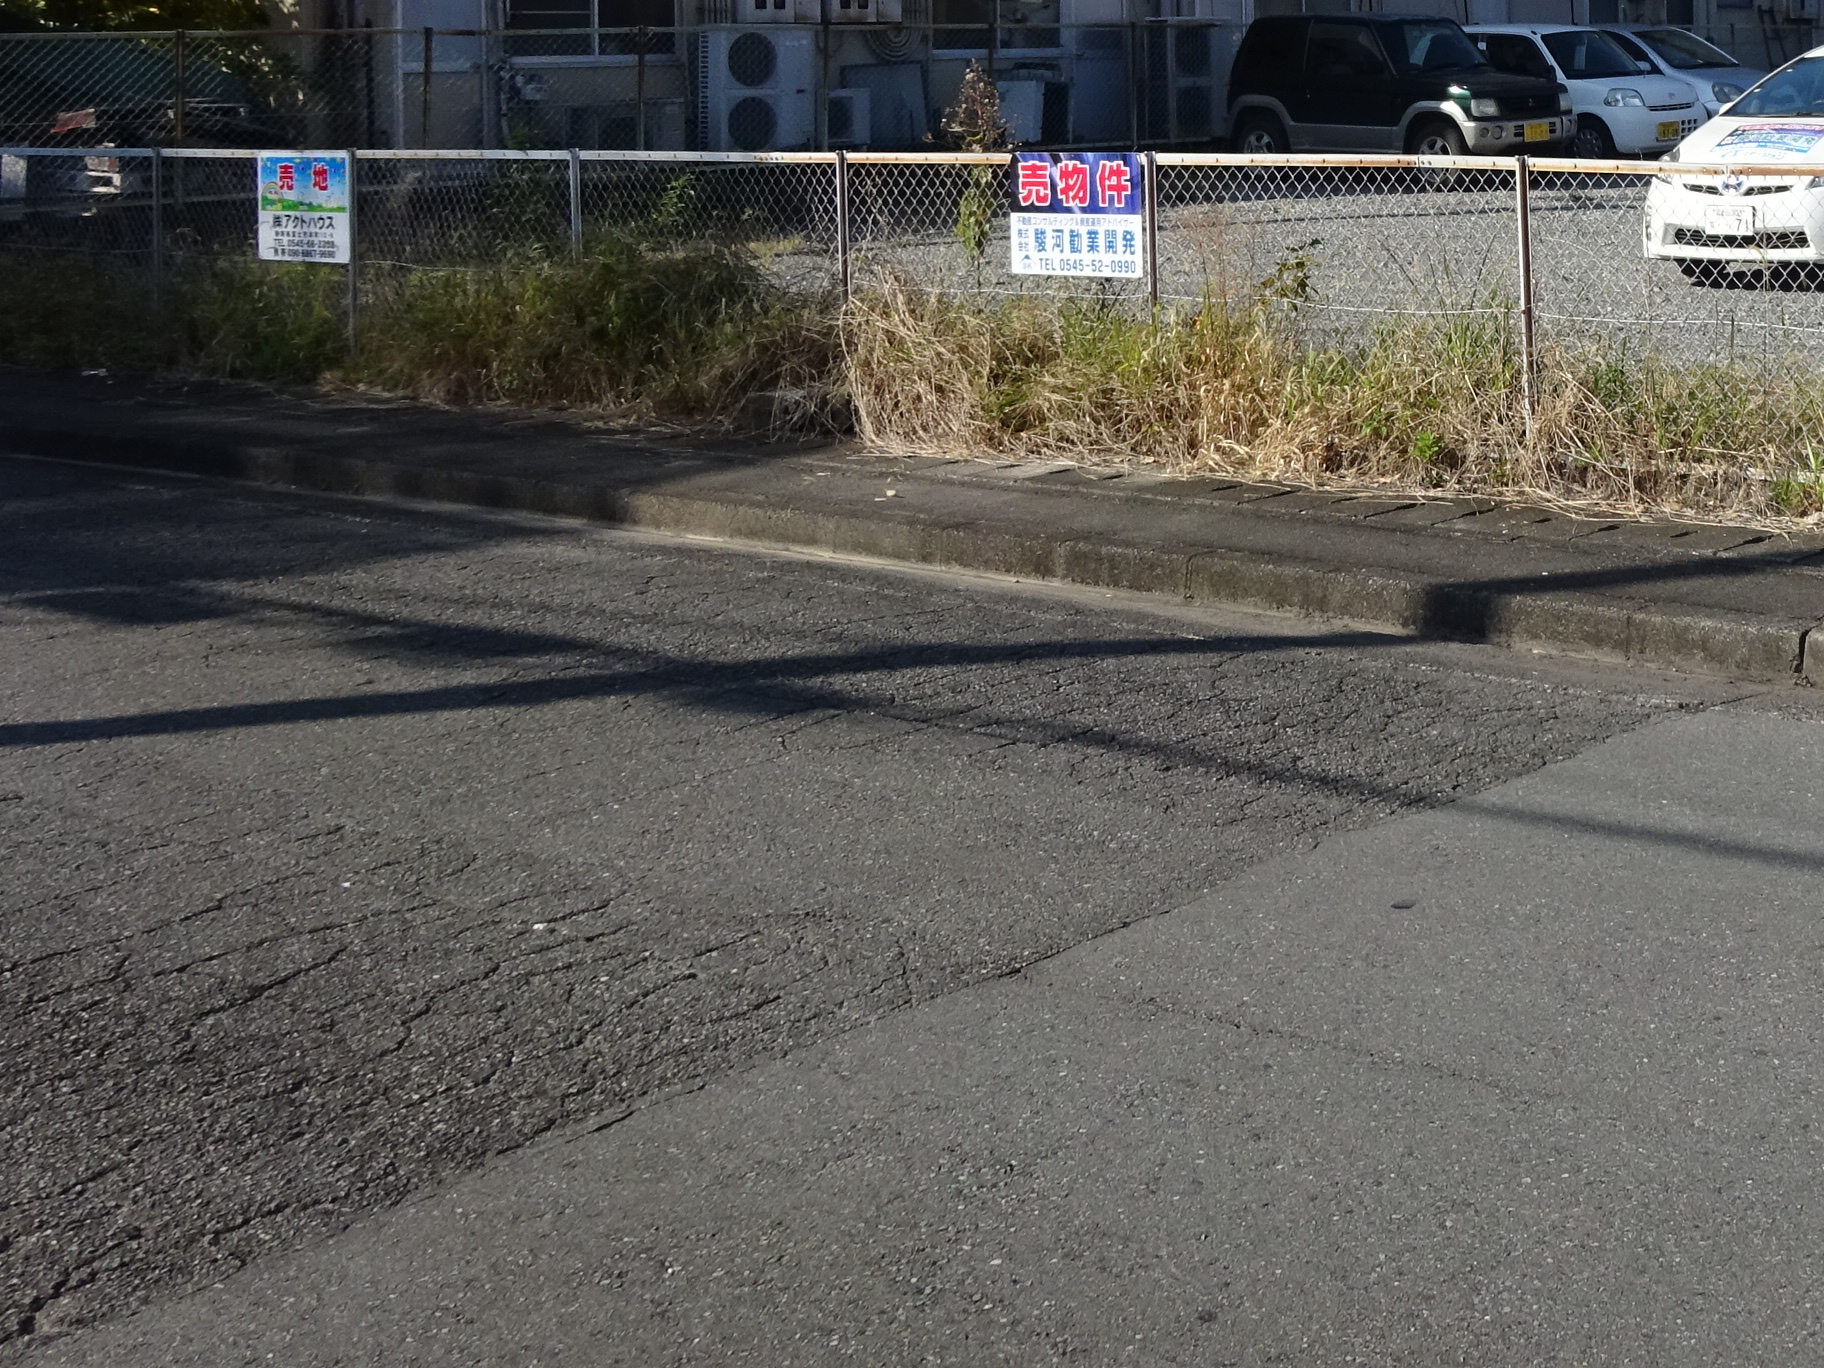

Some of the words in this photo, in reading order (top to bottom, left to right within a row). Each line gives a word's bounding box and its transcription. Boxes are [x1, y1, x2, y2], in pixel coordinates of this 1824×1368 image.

[277, 162, 329, 191] 売地
[1018, 161, 1131, 207] 売物件
[1034, 228, 1136, 255] 駿河勧業開発
[1039, 258, 1057, 271] TEL
[1059, 258, 1136, 273] 0545-52-0990
